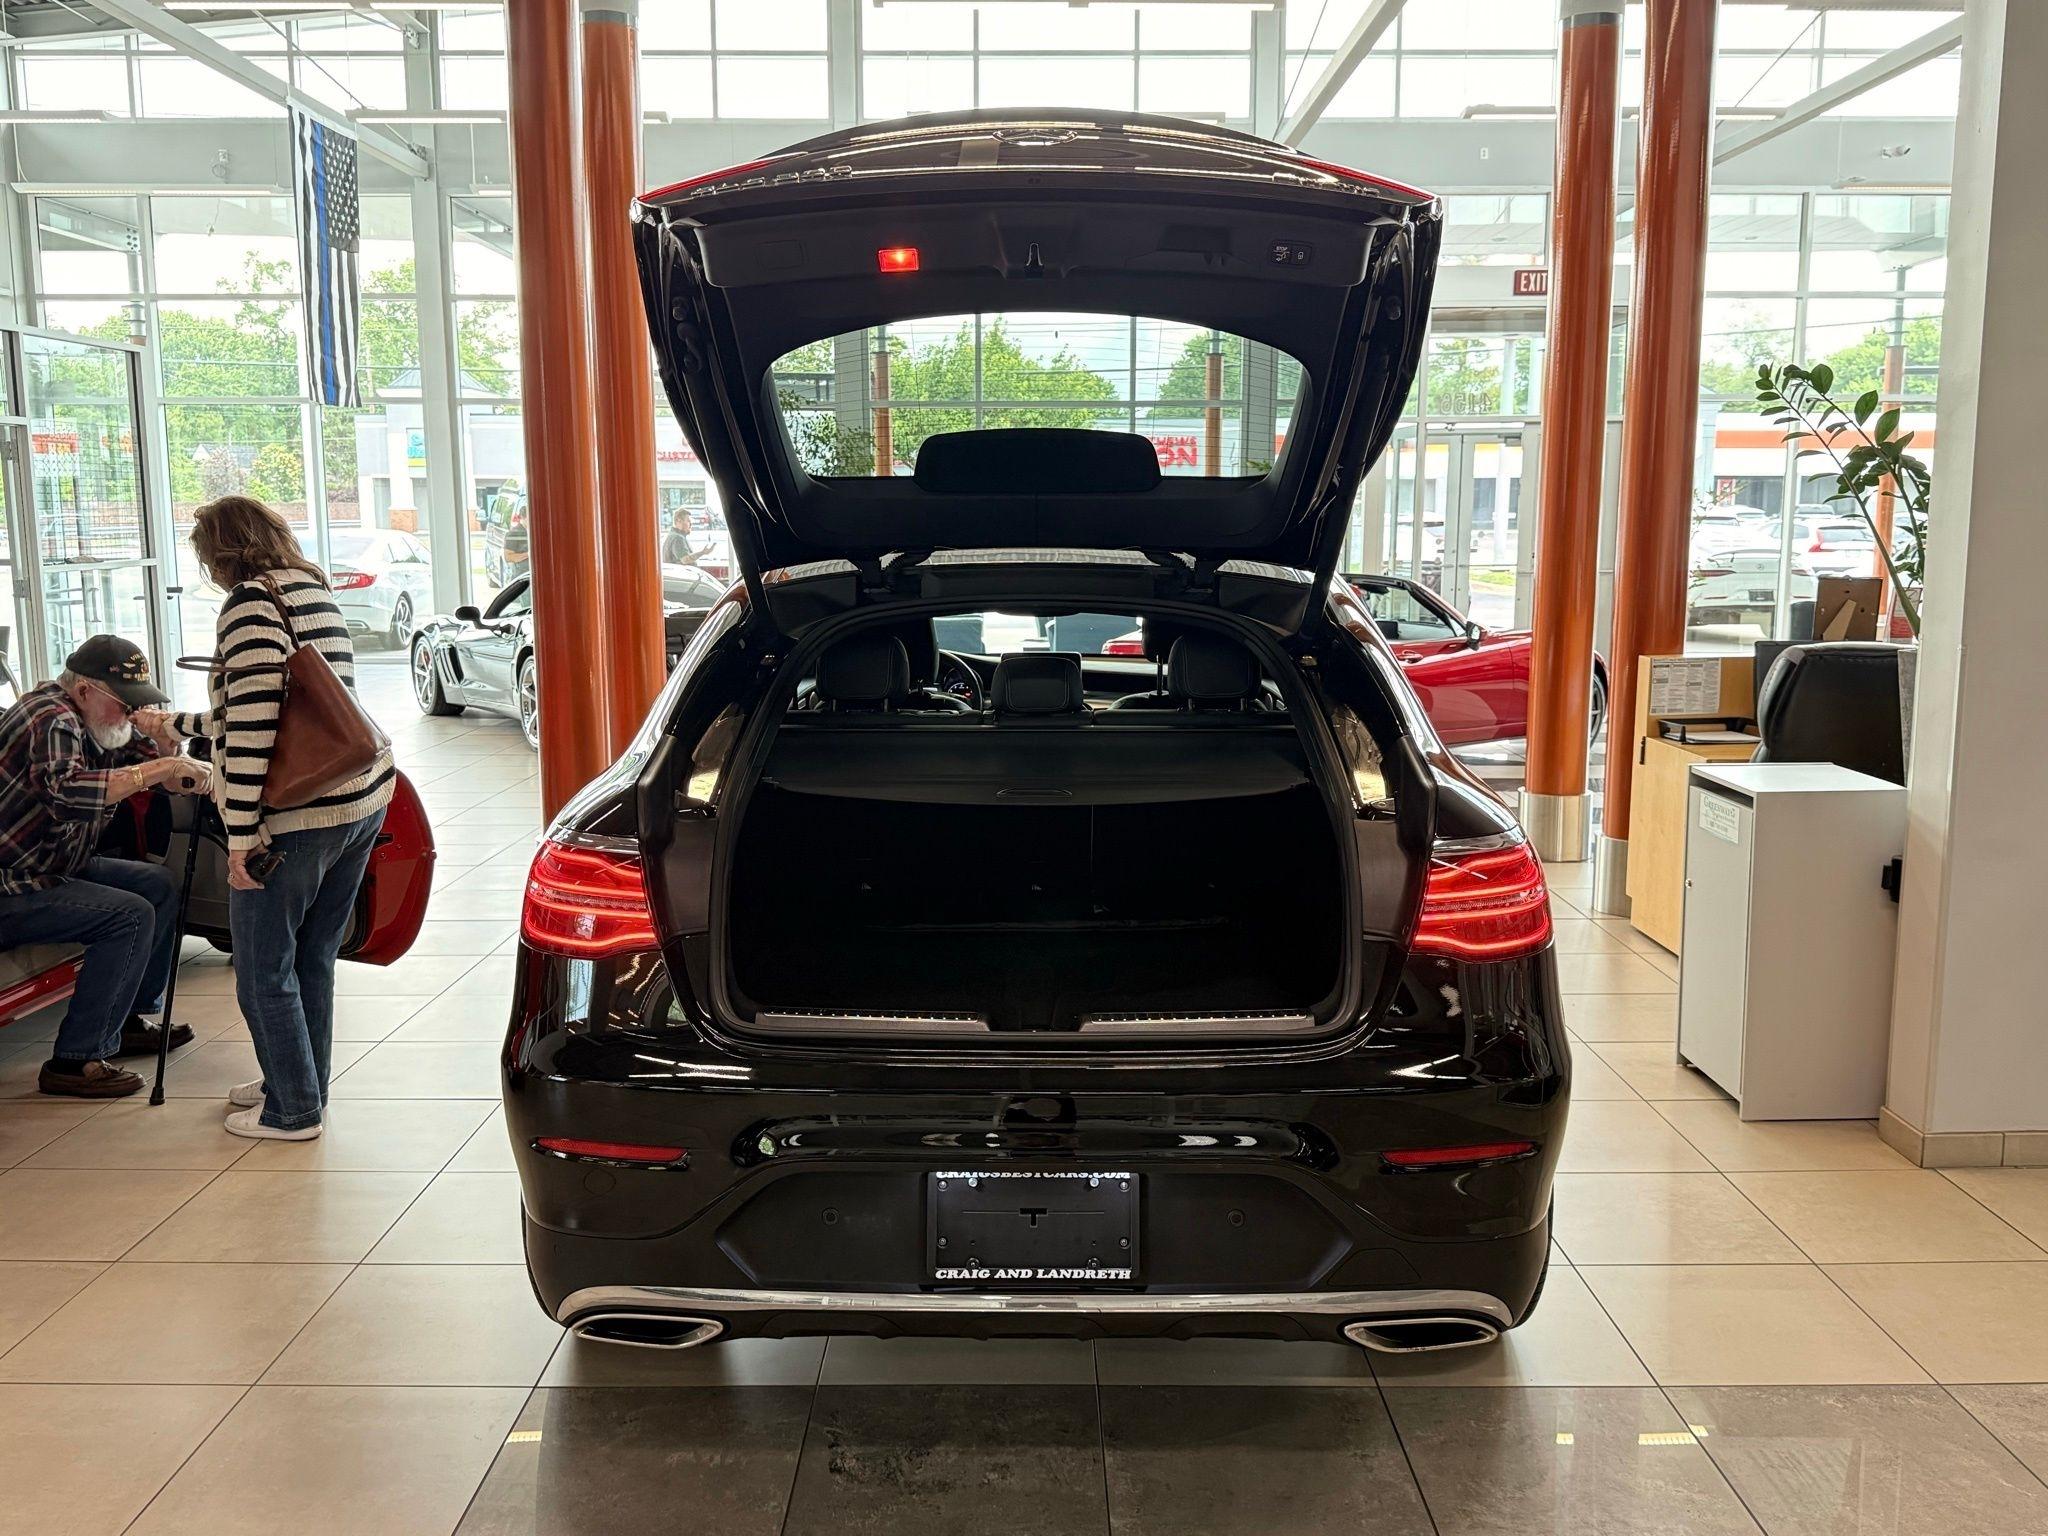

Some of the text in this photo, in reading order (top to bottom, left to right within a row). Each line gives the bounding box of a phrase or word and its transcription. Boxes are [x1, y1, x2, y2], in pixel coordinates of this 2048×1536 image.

[1520, 272, 1547, 292] EXIT
[935, 1269, 1131, 1279] CRAIG AND LANDRETH
